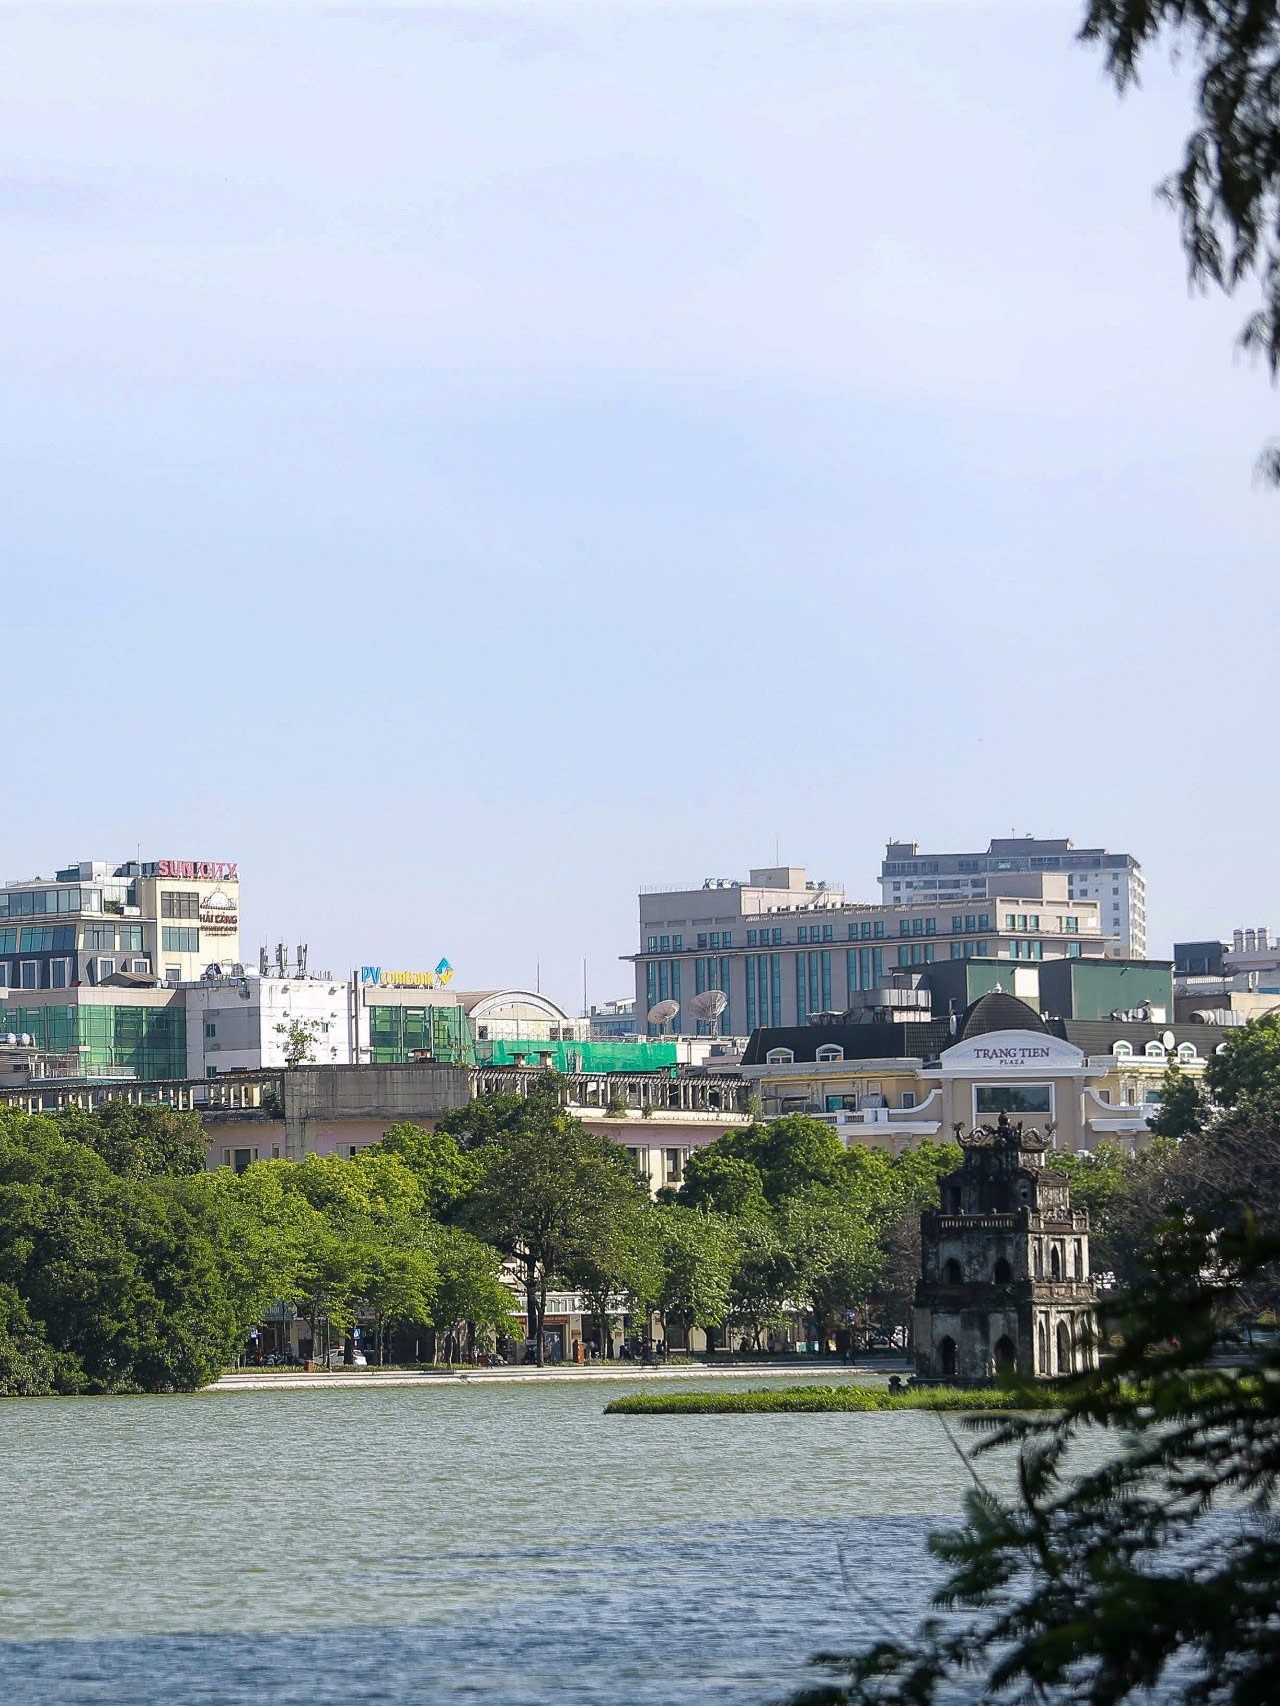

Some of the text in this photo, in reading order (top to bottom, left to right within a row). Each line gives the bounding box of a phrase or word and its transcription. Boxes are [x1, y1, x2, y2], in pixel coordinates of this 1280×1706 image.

[158, 860, 238, 880] SUN CITY
[973, 1047, 1050, 1060] TRANG TIEN
